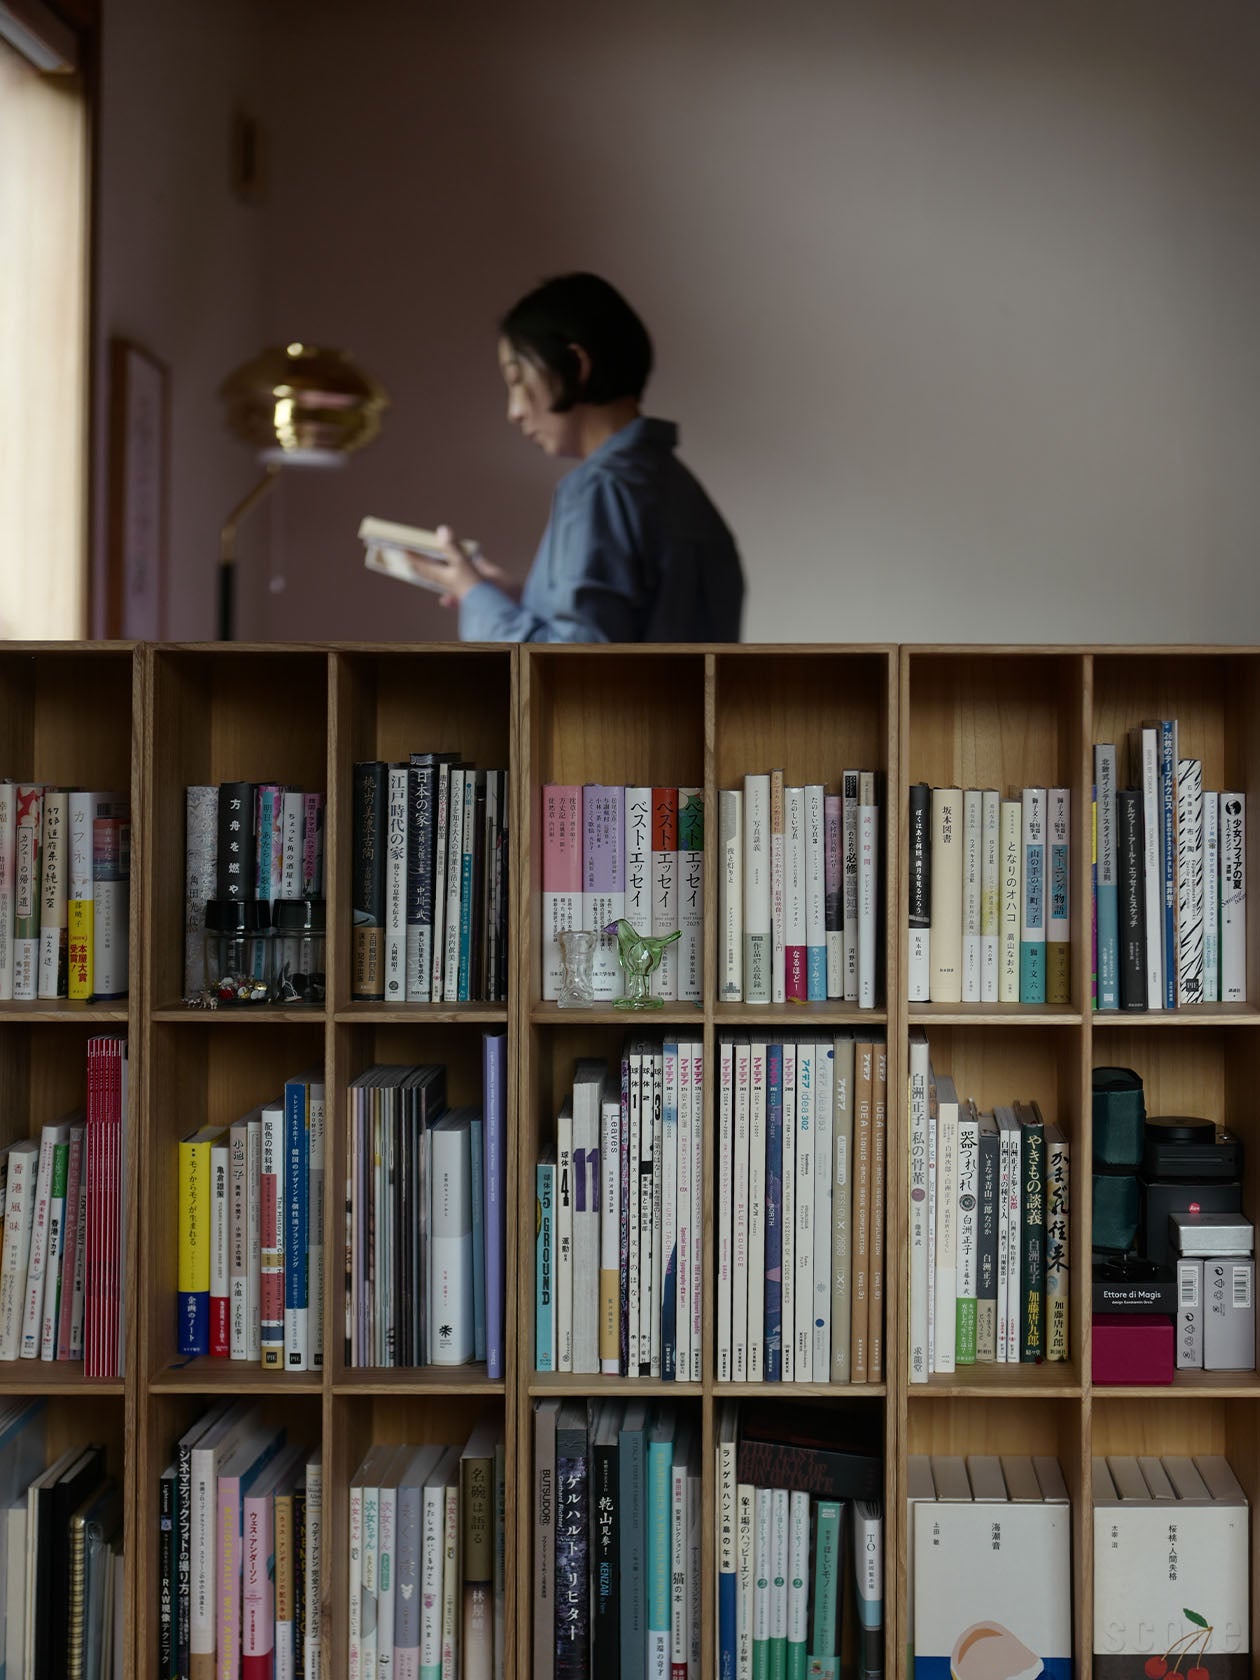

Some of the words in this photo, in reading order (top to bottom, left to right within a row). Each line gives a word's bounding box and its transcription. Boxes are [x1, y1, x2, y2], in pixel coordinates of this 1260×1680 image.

[1163, 731, 1173, 810] 26枚のテーブルクロス
[390, 776, 405, 860] 江戸時代の家
[415, 770, 430, 826] 日本の家
[790, 799, 799, 840] たのしい写真
[942, 806, 952, 843] 坂本図書
[73, 811, 85, 864] カフネ
[286, 813, 295, 896] ちょっと角の酒屋まで
[629, 801, 648, 908] ベスト・エッセイ
[656, 801, 674, 909] ベスト・エッセイ
[684, 801, 701, 908] ベスト・エッセイ
[863, 816, 871, 866] 読む時間
[1127, 799, 1137, 865] アルヴァー・アールト
[1232, 818, 1242, 890] 少女ソフィアの夏
[727, 847, 735, 884] 夜と灯りと
[914, 809, 923, 914] ぼくはあと何回、満月を見るだろう
[1006, 842, 1017, 922] となりのオハコ
[1054, 848, 1065, 915] モーニング物語
[416, 886, 426, 920] 中川武
[1128, 867, 1138, 927] エッセイとスケッチ
[78, 945, 88, 983] 本屋大賞
[792, 949, 800, 991] なるほど!
[1007, 933, 1015, 975] 高山なおみ
[694, 1057, 703, 1085] アイデア
[722, 1058, 730, 1086] アイデア
[739, 1058, 747, 1086] アイデア
[754, 1057, 762, 1085] アイデア
[785, 1058, 793, 1086] アイデア
[802, 1059, 810, 1089] アイデア
[863, 1053, 871, 1081] アイデア
[838, 1078, 847, 1111] アイデア
[860, 1101, 868, 1127] IDEA
[876, 1102, 884, 1128] IDEA
[233, 1140, 244, 1181] 小池一子
[264, 1121, 273, 1174] 配色の教科書
[610, 1114, 620, 1154] Leaves
[216, 1166, 225, 1198] 亀倉雄策
[959, 1131, 978, 1191] 器つれづれ
[1010, 1140, 1018, 1210] 白洲正子と歩く京都
[1026, 1134, 1042, 1225] やきもの談義
[9, 1163, 22, 1232] 香港風味
[189, 1160, 198, 1246] モノからモノが生まれる
[983, 1153, 993, 1235] いまなぜ青山二郎なのか
[1048, 1151, 1070, 1273] かまぐれ往来
[962, 1214, 973, 1256] 白洲正子
[1028, 1239, 1040, 1284] 白洲正子
[983, 1253, 992, 1289] 白洲正子
[1103, 1290, 1127, 1299] Ettore
[1128, 1290, 1137, 1299] di
[1138, 1290, 1161, 1300] Magis
[1027, 1290, 1040, 1347] 加藤唐九郎
[1053, 1300, 1064, 1348] 加藤唐九郎
[541, 1469, 551, 1525] BUTSUDORI
[722, 1449, 731, 1569] ランゲルハンス島の午後
[249, 1511, 257, 1585] ウェス・アンダーソン
[426, 1502, 435, 1586] わたしのぬいぐるみさん
[598, 1496, 614, 1557] 乾山見参!
[740, 1496, 750, 1591] 象工場のハッピーエンド
[932, 1522, 940, 1545] 上田敏
[991, 1522, 1000, 1550] 海潮音
[1111, 1525, 1119, 1548] 太宰治
[1168, 1524, 1178, 1581] 桜桃・人間失格
[565, 1473, 582, 1641] ゲルハルト・リヒター
[600, 1561, 610, 1597] KENZAN
[673, 1572, 684, 1603] 猫の本
[160, 1578, 171, 1664] RAW現像テクニック
